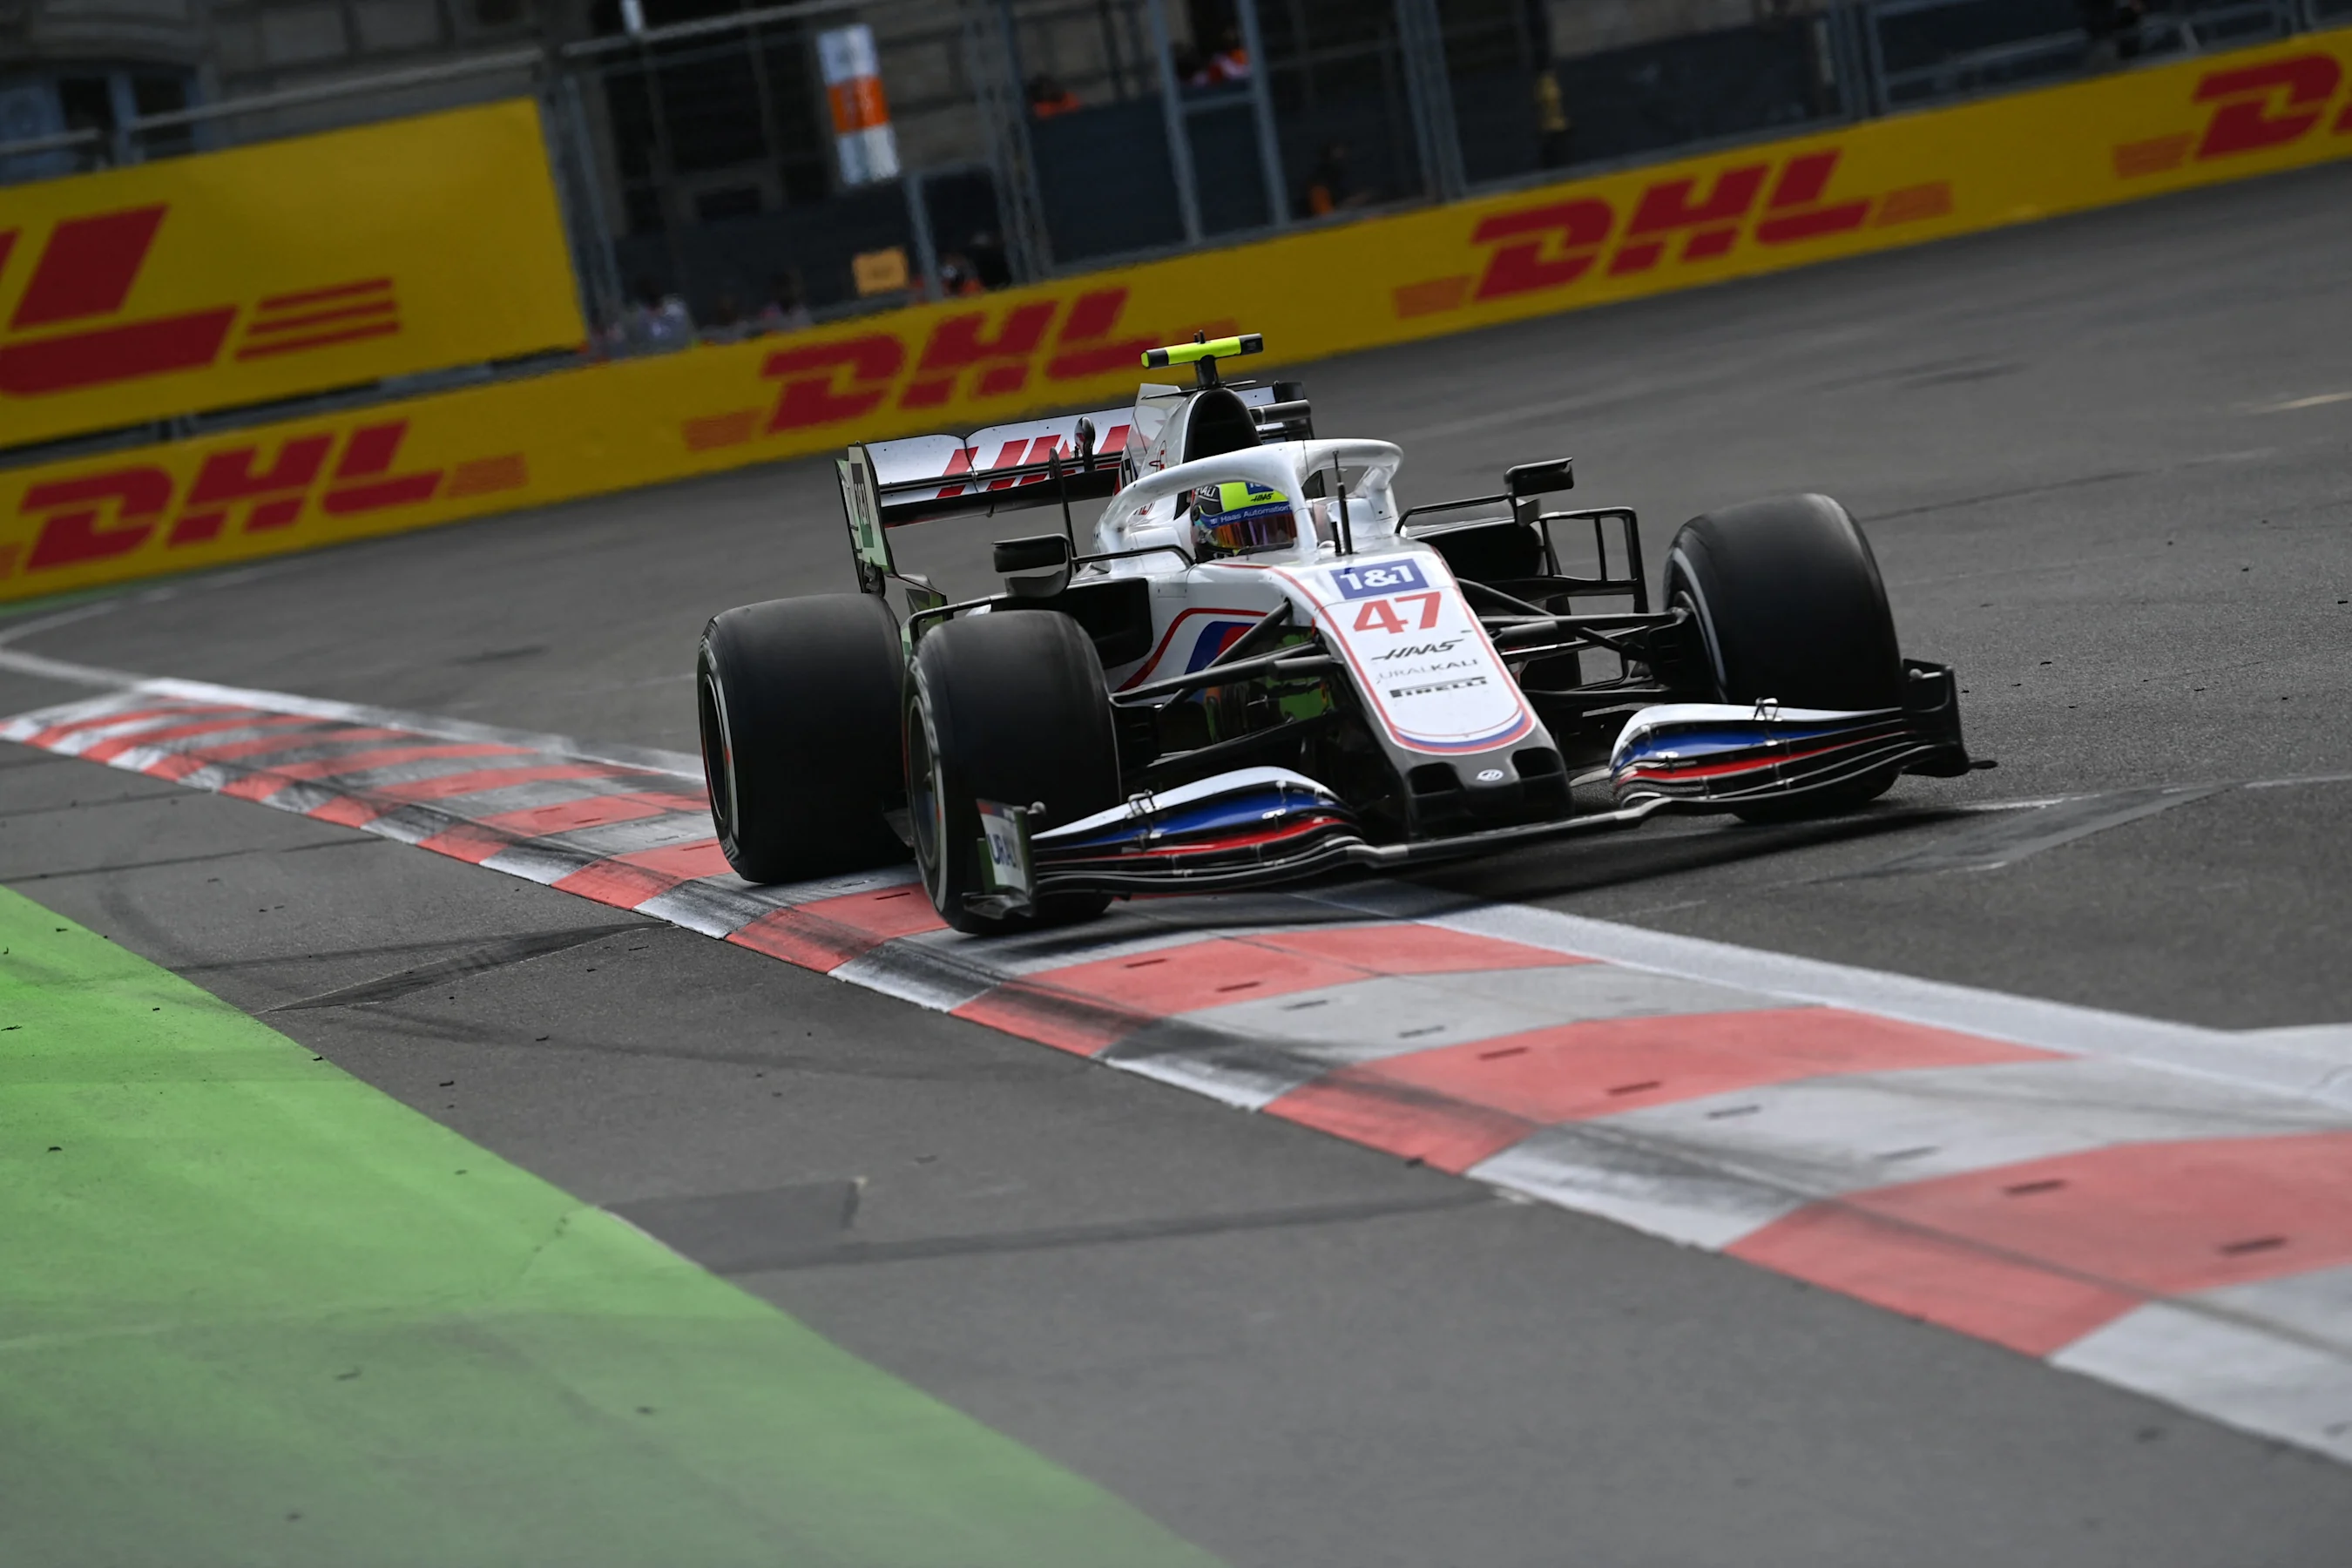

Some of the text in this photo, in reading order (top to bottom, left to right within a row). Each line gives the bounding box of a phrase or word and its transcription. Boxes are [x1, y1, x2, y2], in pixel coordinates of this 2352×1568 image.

[2192, 51, 2352, 162] D
[1470, 149, 1872, 302] DHL
[759, 287, 1161, 436] DHL
[19, 421, 443, 573] DHL
[1220, 512, 1241, 524] Haas
[1243, 504, 1289, 517] Automation
[1340, 565, 1416, 591] 1&1
[1353, 591, 1442, 634] 47
[1370, 639, 1464, 660] HAAS
[1377, 659, 1478, 679] URALKALI
[1389, 676, 1488, 699] PIRELLI
